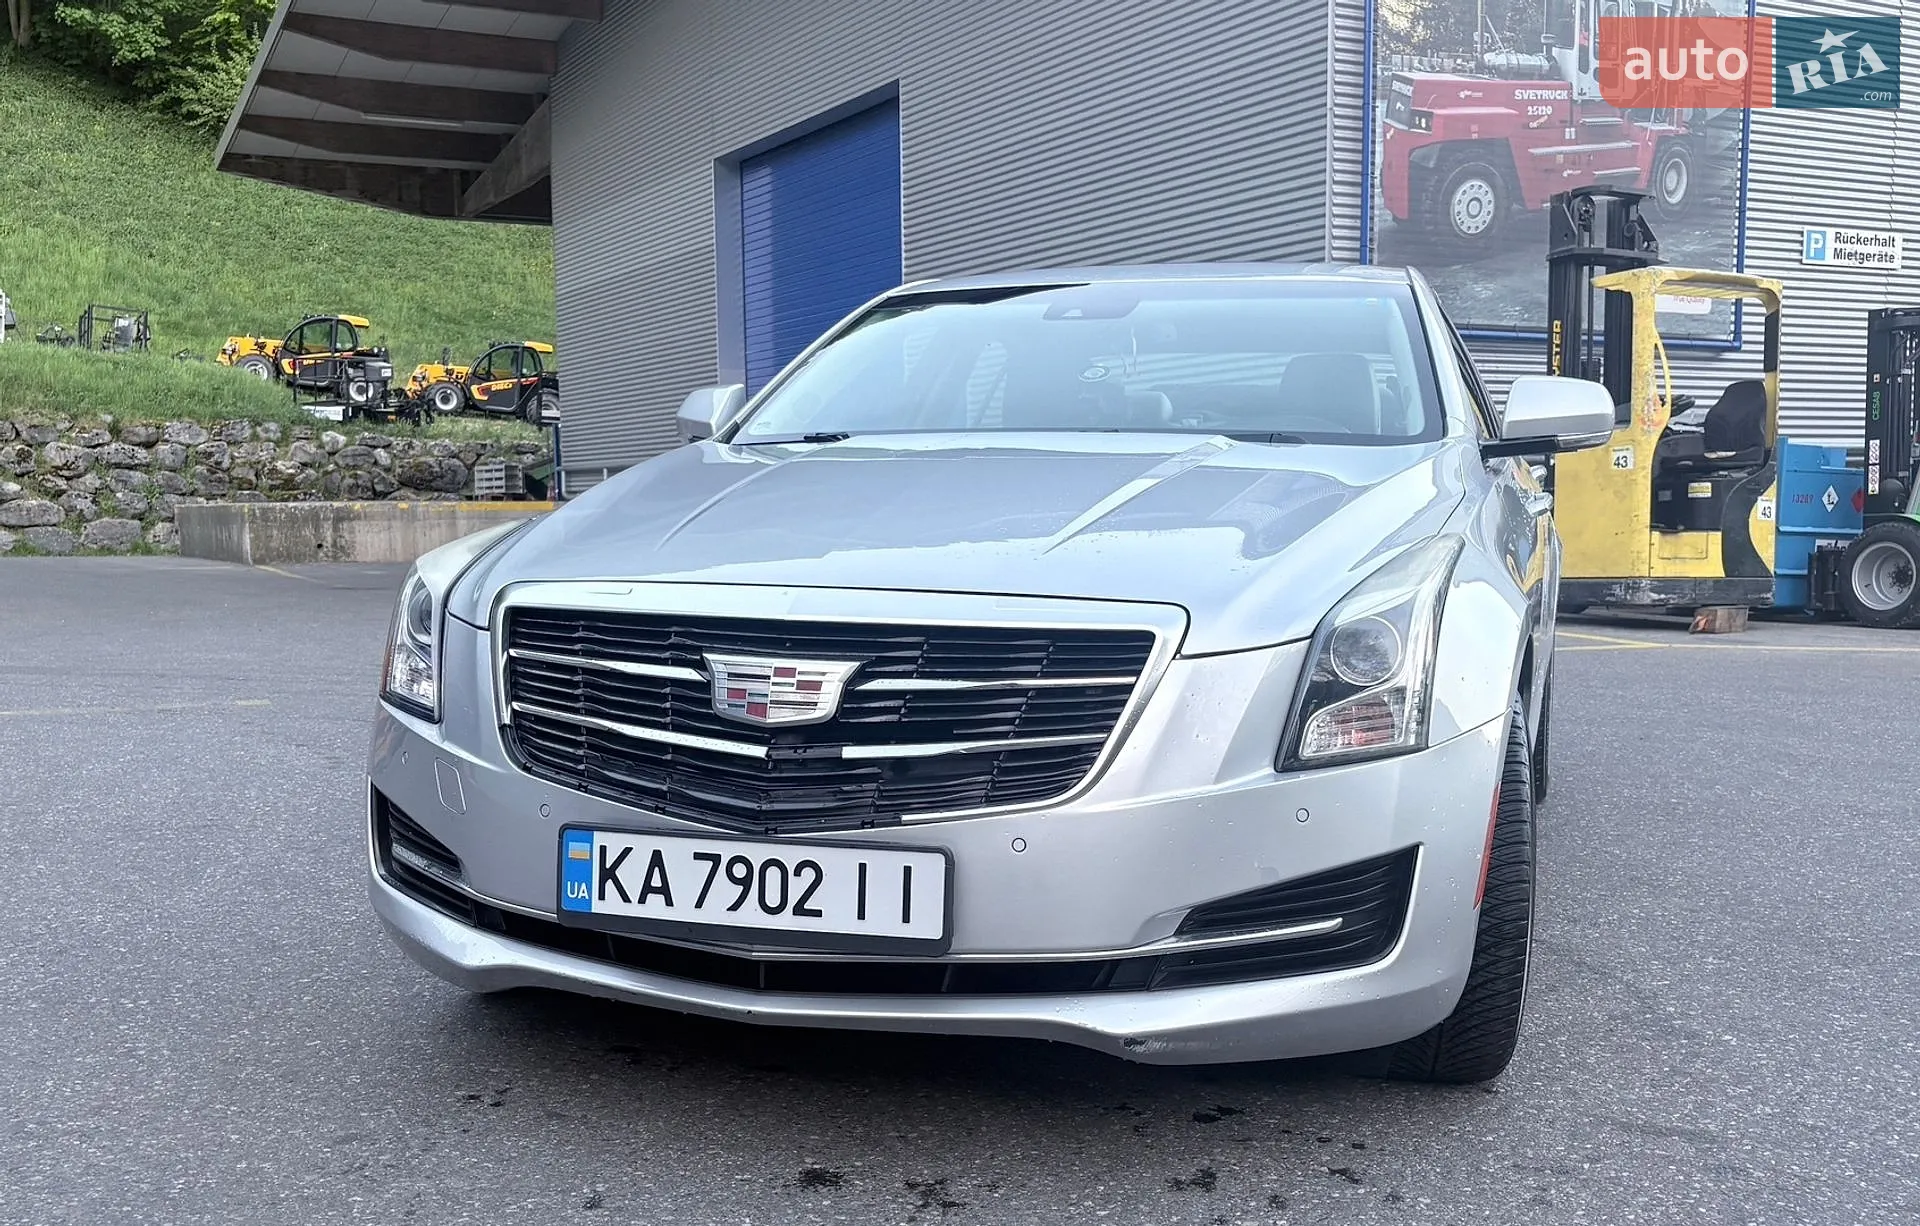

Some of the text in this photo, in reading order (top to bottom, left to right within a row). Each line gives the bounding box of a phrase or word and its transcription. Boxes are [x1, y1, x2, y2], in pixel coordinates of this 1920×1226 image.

[1514, 89, 1569, 100] SVETRUCK
[1834, 231, 1896, 248] Rückerhalt
[1833, 247, 1895, 264] Mietgeräte
[1552, 319, 1562, 376] YSTER
[1613, 455, 1628, 469] 43
[1761, 506, 1772, 519] 43
[597, 844, 675, 908] KA
[692, 851, 824, 919] 7902
[566, 881, 590, 900] UA
